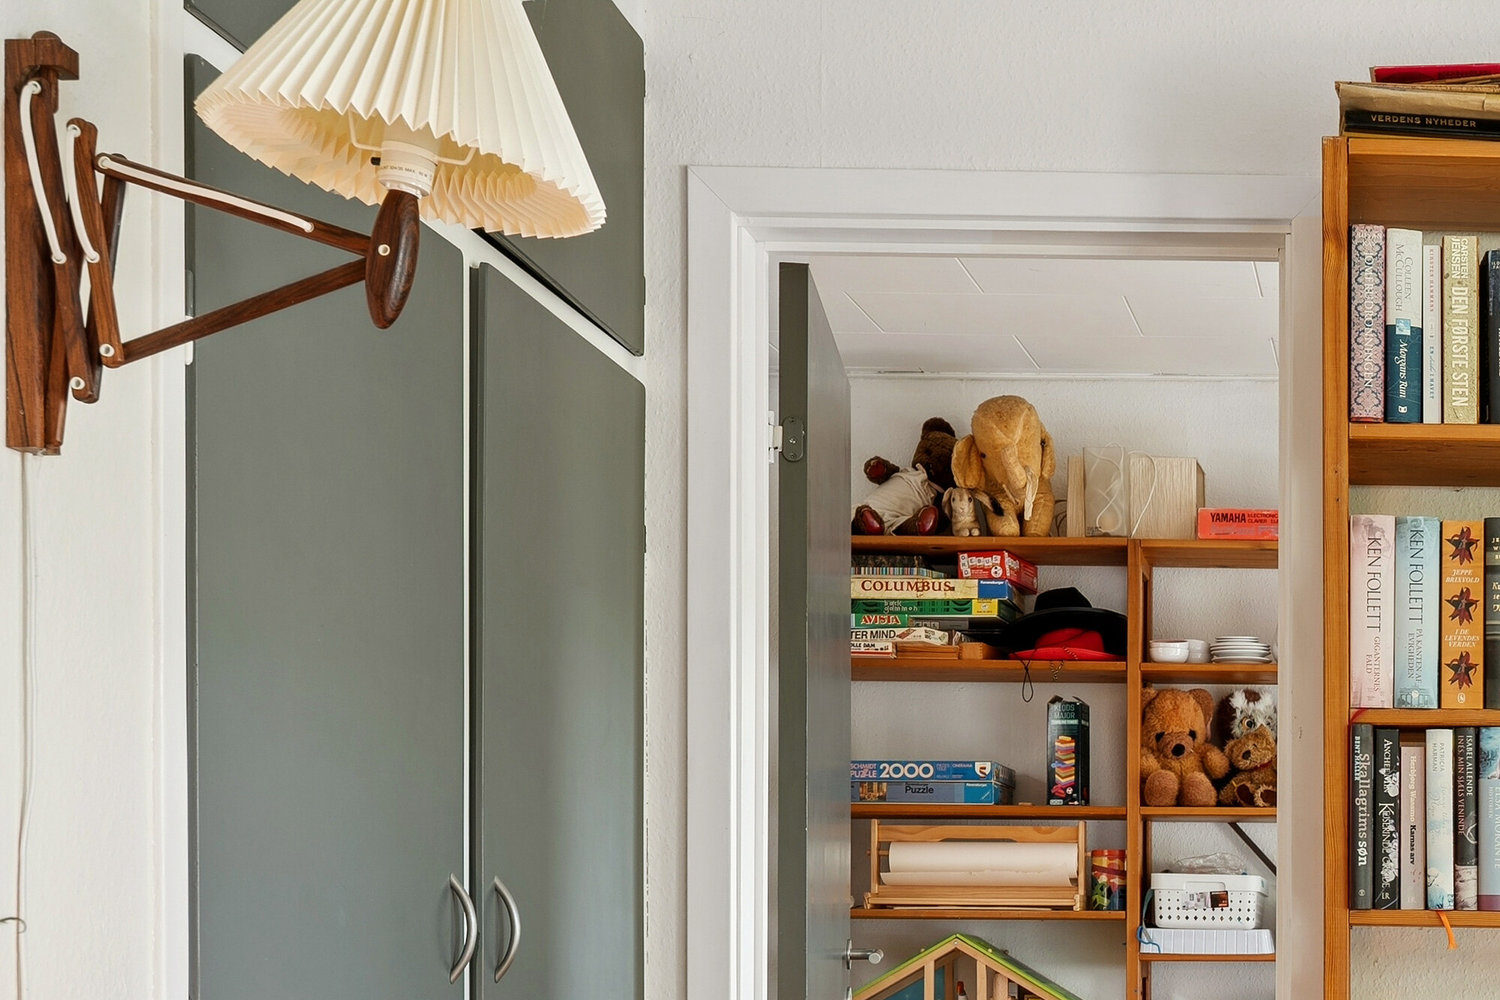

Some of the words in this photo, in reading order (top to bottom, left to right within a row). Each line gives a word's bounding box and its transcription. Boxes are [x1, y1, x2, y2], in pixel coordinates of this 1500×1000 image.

[1371, 114, 1421, 124] VERDENS
[1425, 118, 1477, 128] NYHEDER
[1451, 237, 1461, 279] JENSEN
[1460, 238, 1468, 279] CARSTEN
[1451, 286, 1469, 314] DEN
[1451, 319, 1469, 368] FØRSTE
[1451, 374, 1469, 407] STEN
[1210, 512, 1246, 523] YAMAHA
[1367, 537, 1382, 567] KEN
[1409, 529, 1425, 560] KEN
[861, 580, 952, 592] COLUMBUS
[1451, 569, 1474, 577] JEPPE
[1366, 571, 1382, 632] FOLLETT
[1408, 564, 1424, 624] FOLLETT
[860, 614, 901, 625] AVISTA
[869, 629, 896, 639] MIND
[879, 762, 935, 779] 2000
[905, 785, 935, 795] Puzzle
[1355, 753, 1370, 839] Skallagrims
[1357, 840, 1368, 867] søn
